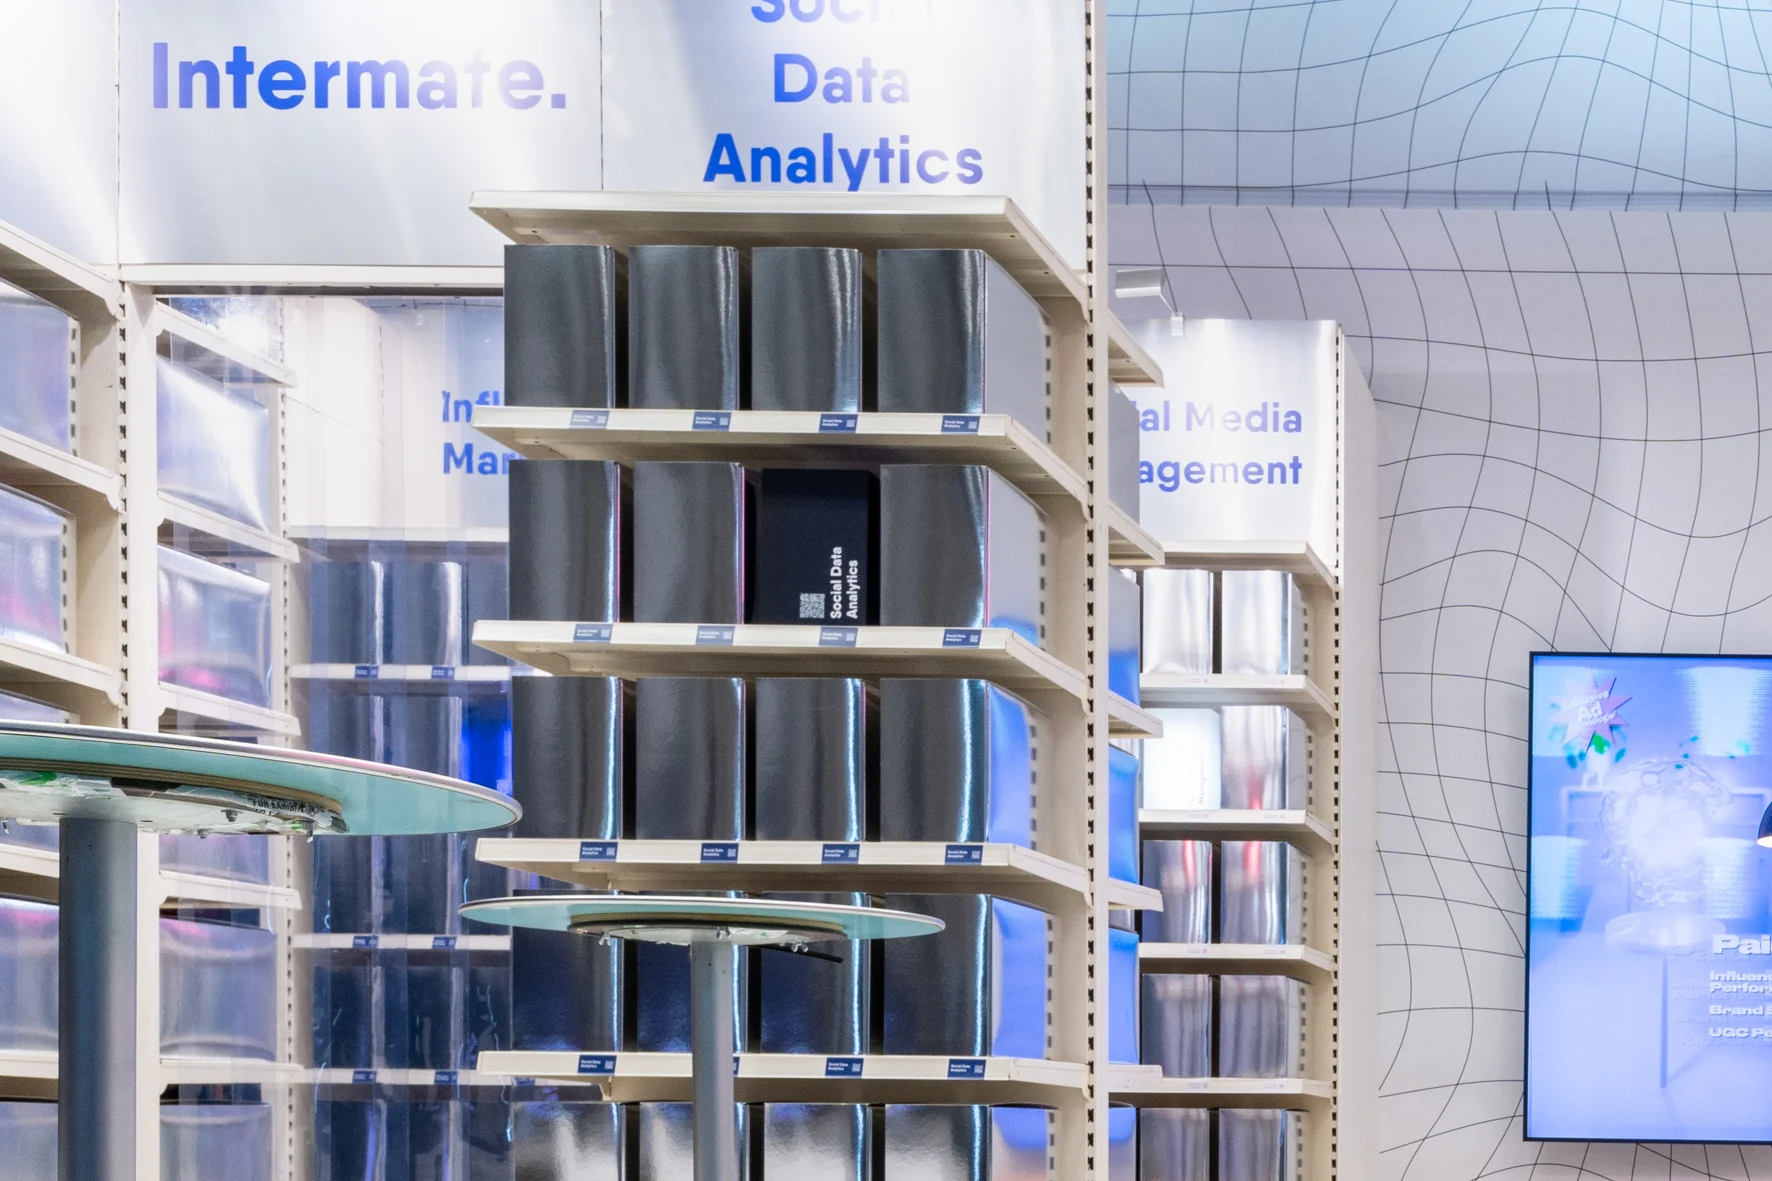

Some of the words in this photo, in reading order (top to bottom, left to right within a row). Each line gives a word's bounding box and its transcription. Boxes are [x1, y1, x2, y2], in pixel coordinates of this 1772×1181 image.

[152, 41, 567, 110] Intermate.
[772, 53, 910, 104] Data
[702, 132, 984, 192] Analytics
[1185, 401, 1303, 433] Media
[1139, 455, 1303, 493] agement
[830, 547, 842, 577] Data
[830, 580, 842, 619] Social
[846, 560, 861, 619] Analytics
[1709, 1005, 1764, 1016] Brand
[1709, 1027, 1749, 1039] UGC
